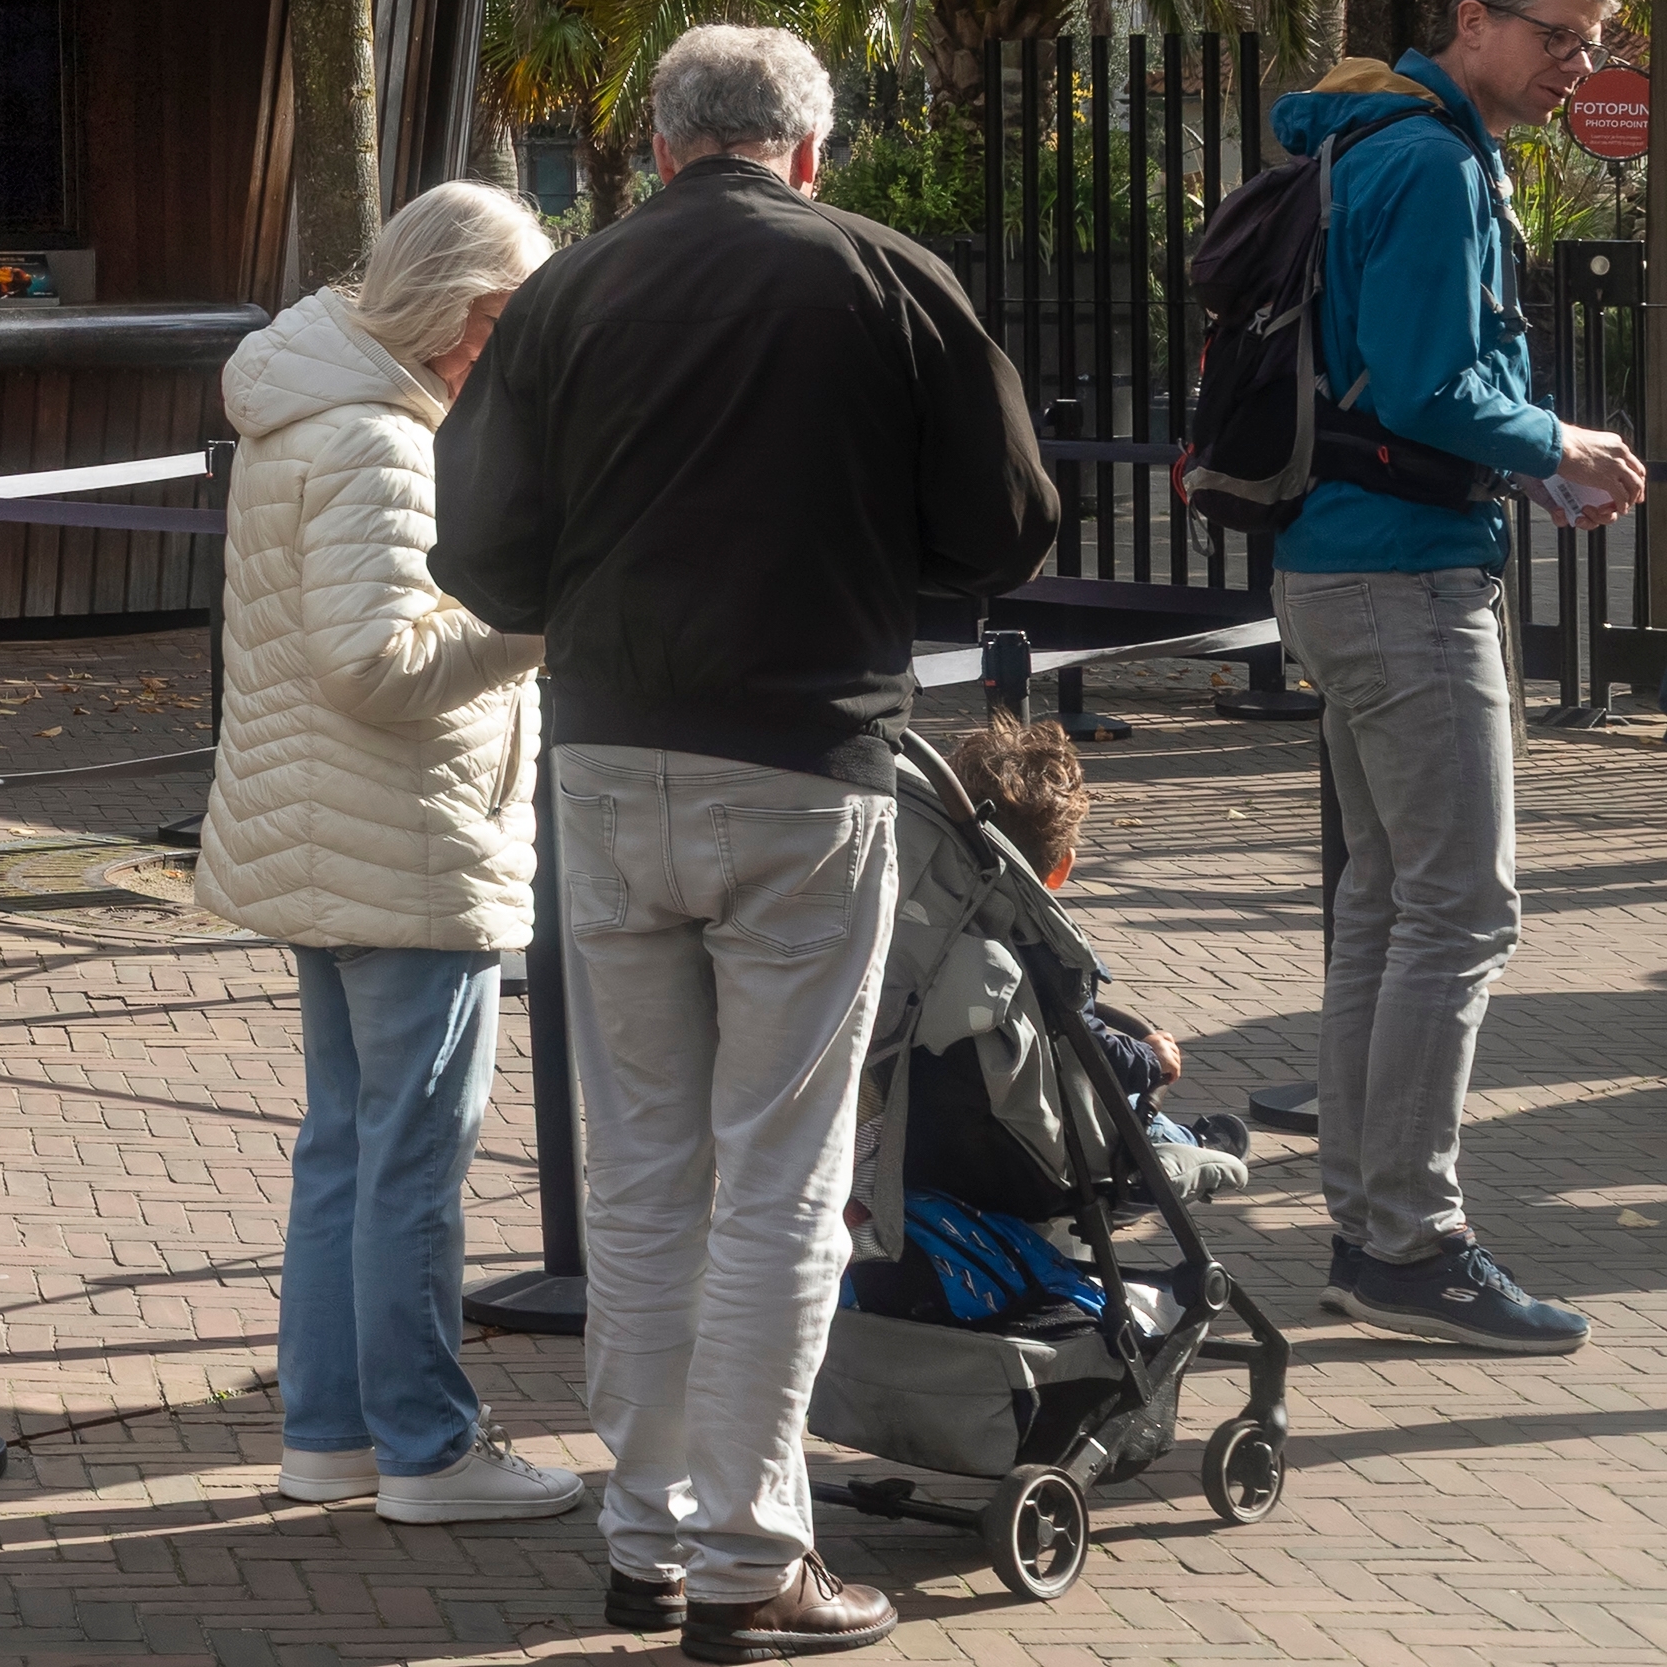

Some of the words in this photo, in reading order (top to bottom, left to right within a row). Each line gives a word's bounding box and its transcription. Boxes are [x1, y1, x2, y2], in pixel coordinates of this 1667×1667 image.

[1574, 102, 1649, 116] FOTOPUN
[1585, 119, 1619, 128] PHOTO
[1619, 120, 1648, 129] POINT
